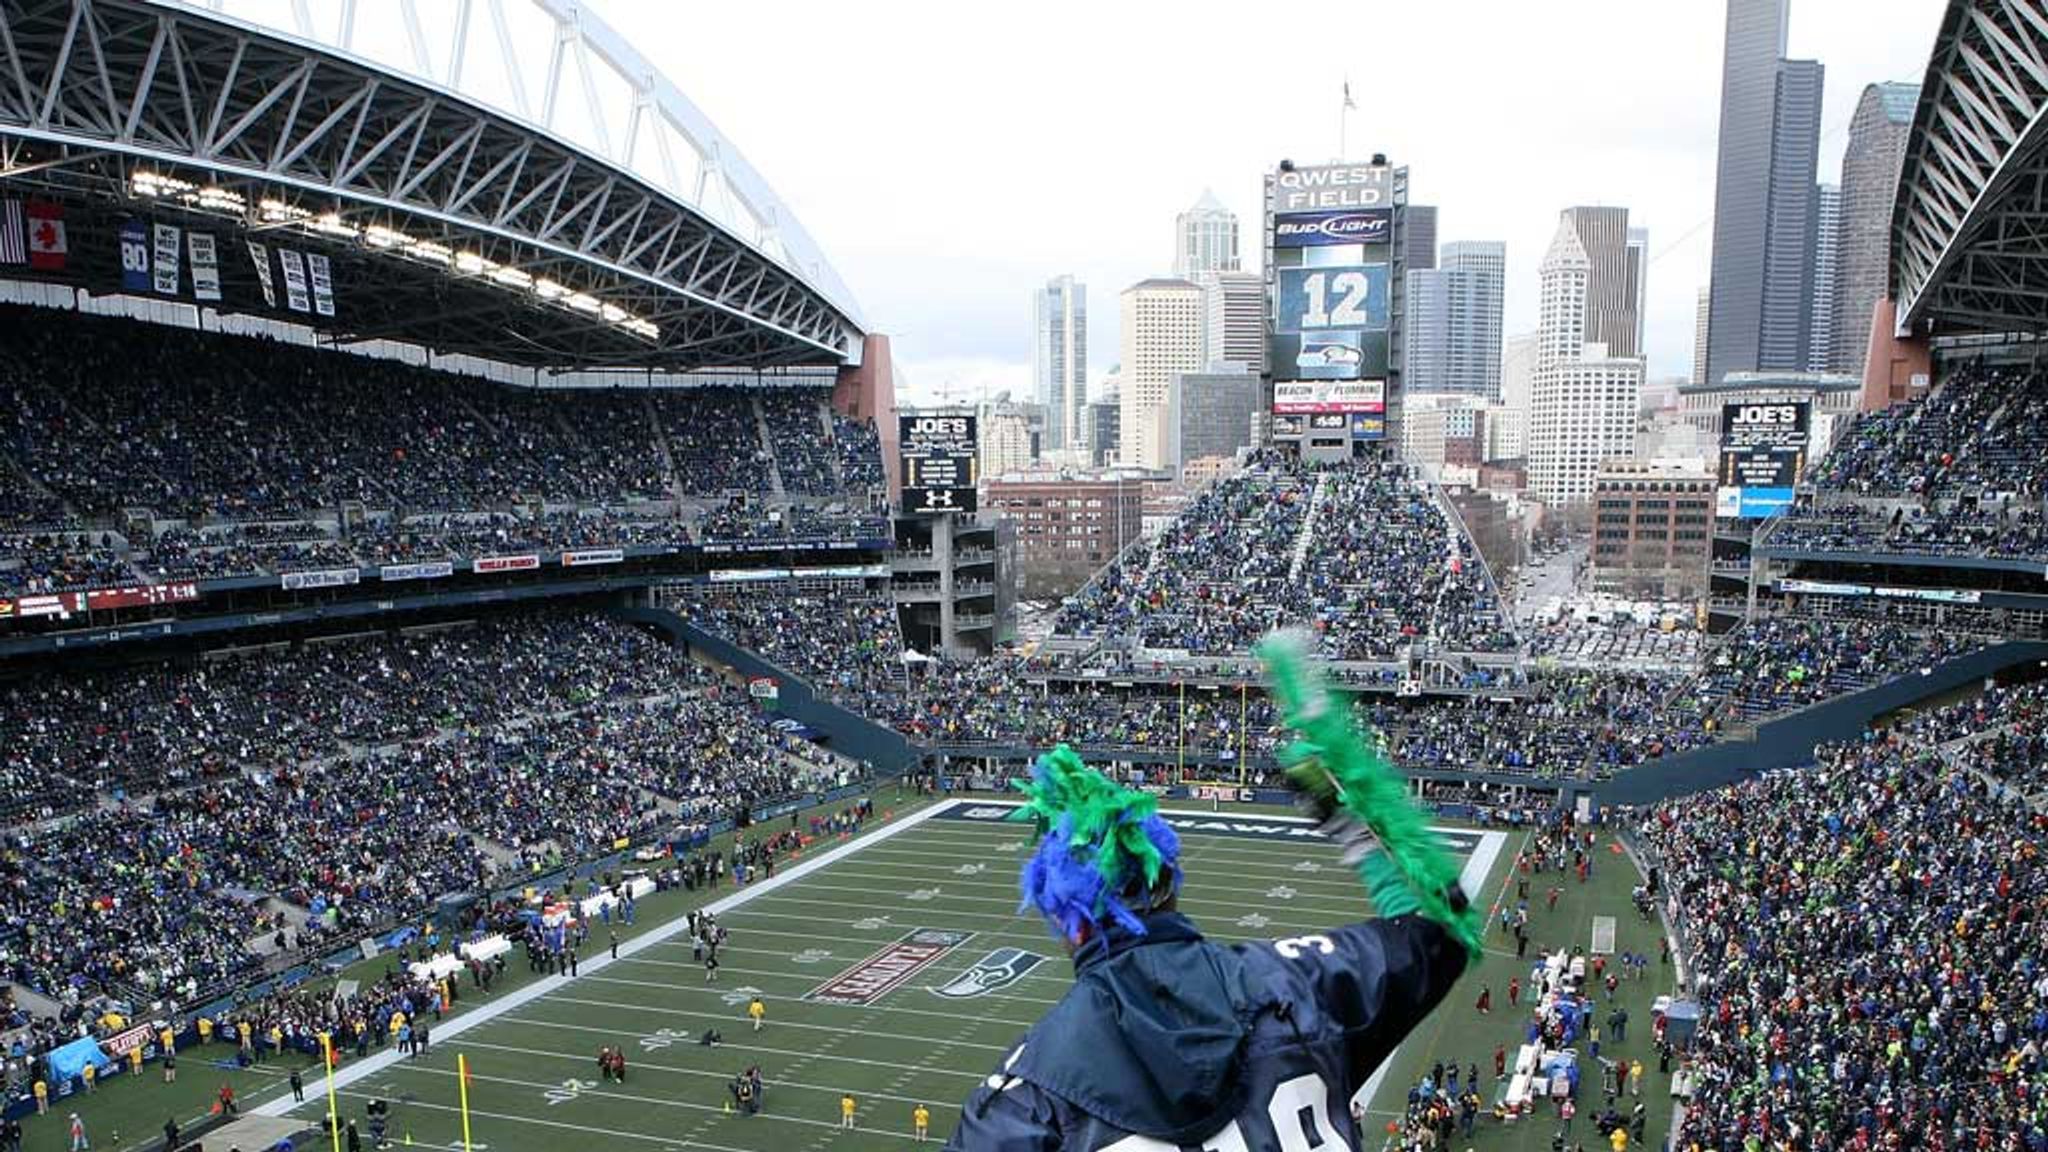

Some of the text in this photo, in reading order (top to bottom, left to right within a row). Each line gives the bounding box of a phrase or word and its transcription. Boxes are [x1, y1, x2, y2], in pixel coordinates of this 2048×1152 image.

[1279, 167, 1388, 188] QWEST
[1288, 189, 1380, 209] FIELD
[1328, 219, 1388, 232] LIGHT
[121, 241, 149, 273] 80
[1302, 272, 1369, 328] 12
[1277, 384, 1381, 396] BEACON PLUMBING
[1731, 405, 1797, 424] JOE'S
[909, 418, 967, 434] JOE'S
